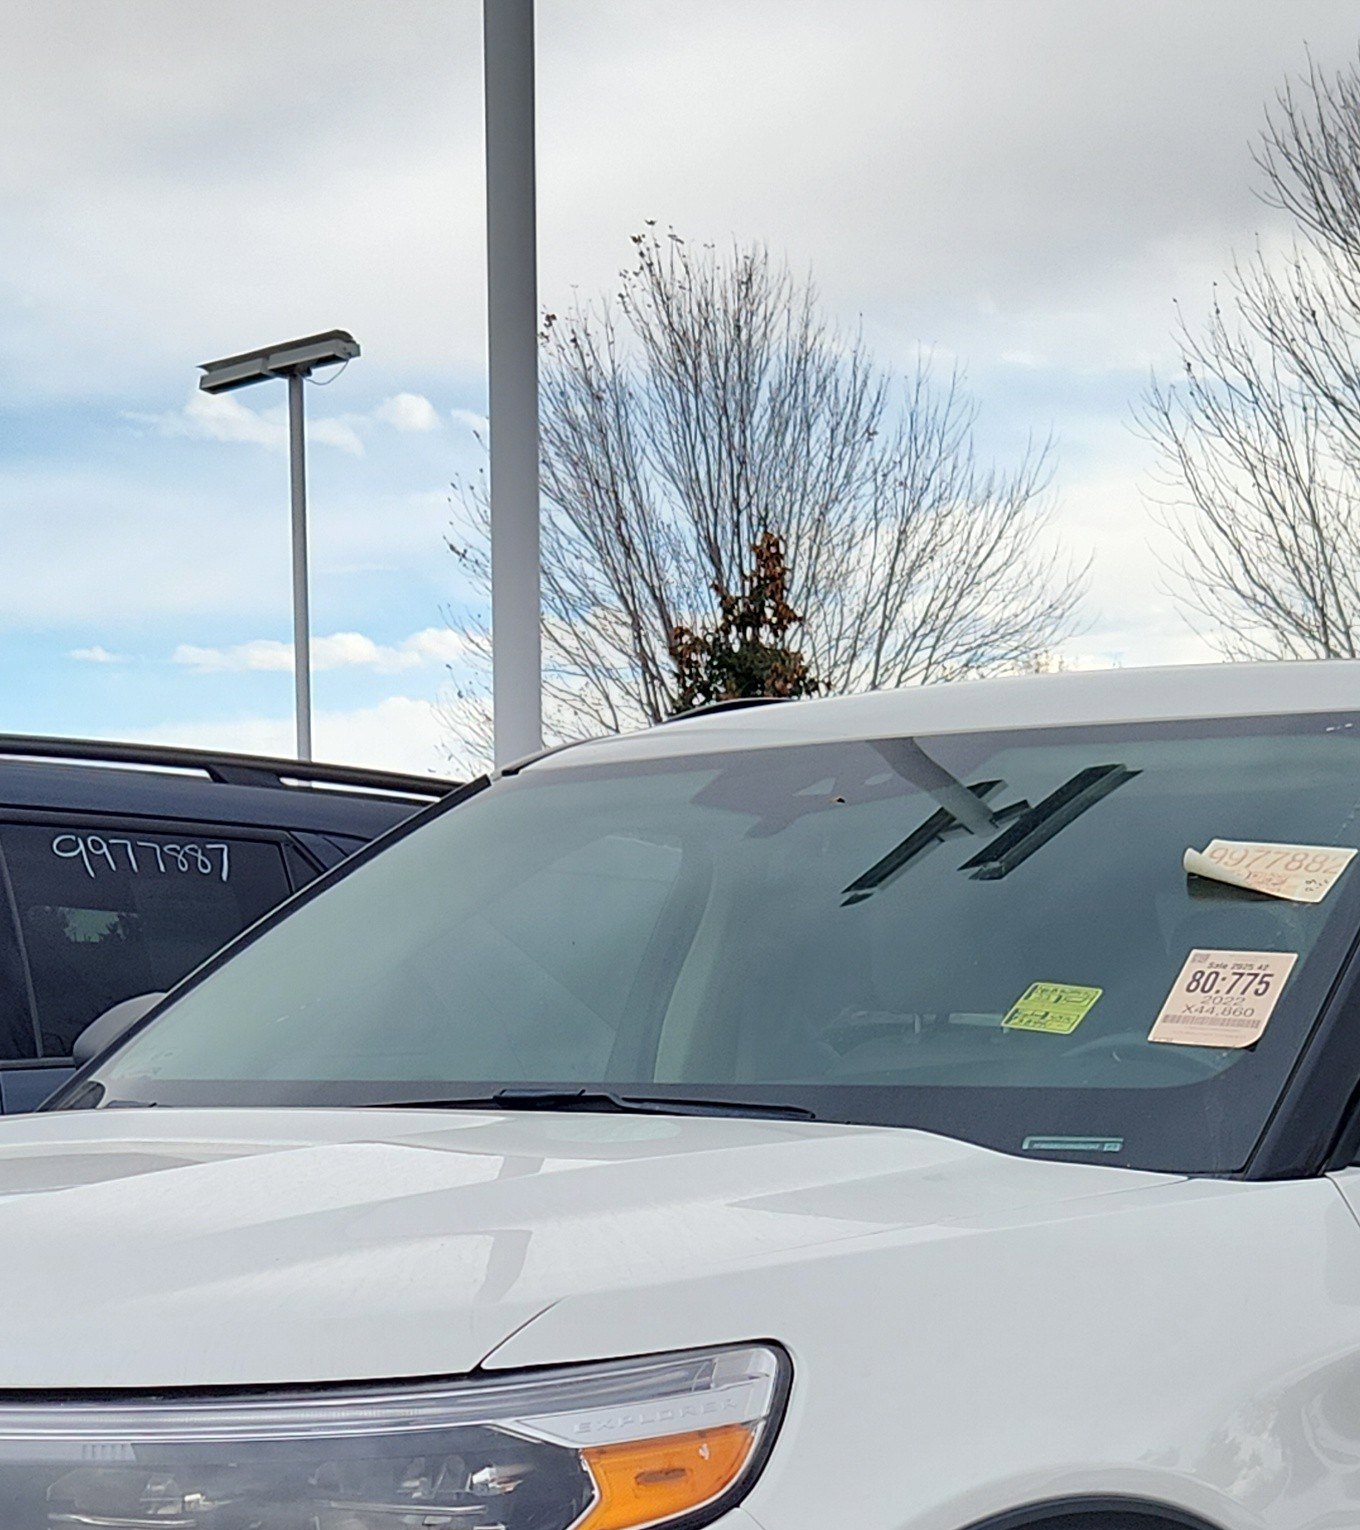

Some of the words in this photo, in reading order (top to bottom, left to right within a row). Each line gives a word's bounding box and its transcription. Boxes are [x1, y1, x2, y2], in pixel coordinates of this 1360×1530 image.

[52, 834, 228, 882] 9977887
[1185, 970, 1274, 997] 80:775
[1200, 996, 1247, 1007] 2022
[573, 1398, 739, 1434] EXPLORER
